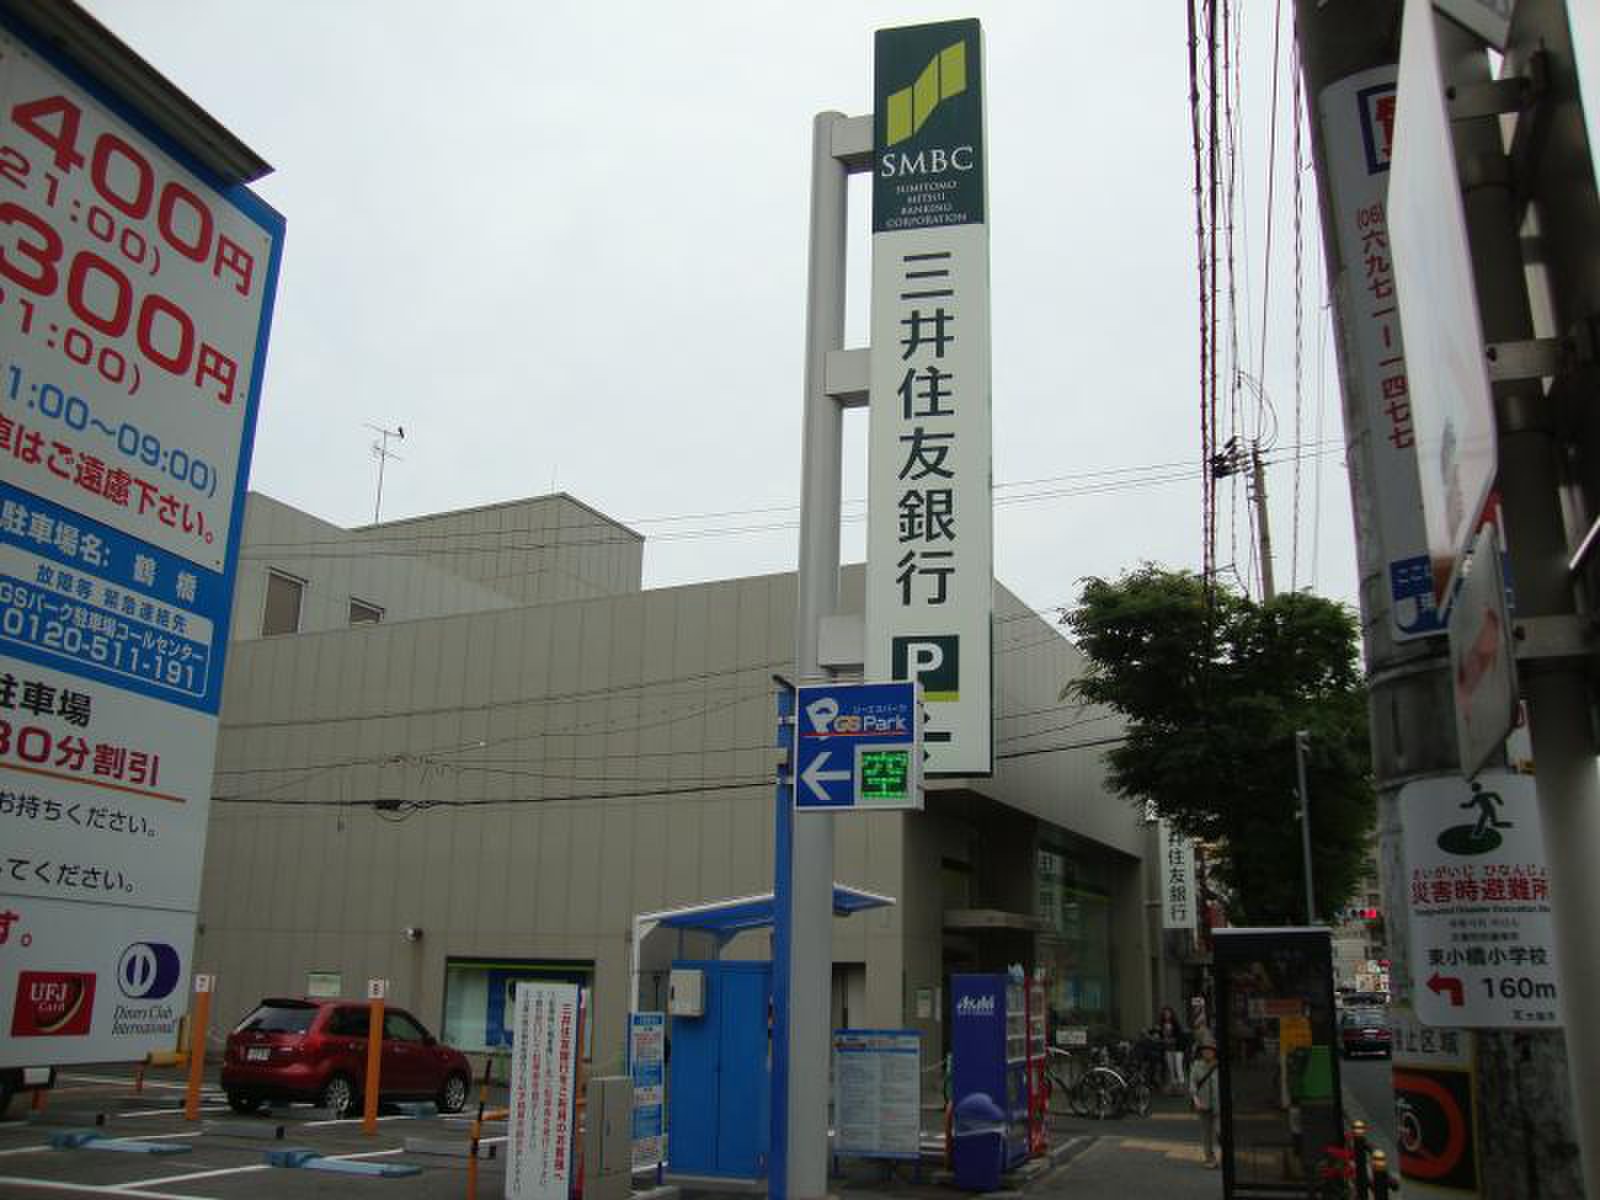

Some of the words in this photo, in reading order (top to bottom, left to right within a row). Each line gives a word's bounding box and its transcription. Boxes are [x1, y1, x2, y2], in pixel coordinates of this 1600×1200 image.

[11, 95, 254, 297] 400円
[880, 145, 974, 178] SMBC
[0, 201, 239, 405] 300円
[895, 250, 957, 607] 三井住友銀行
[3, 608, 195, 690] 0120-511-191
[907, 642, 944, 683] P
[1481, 975, 1557, 1000] 160m
